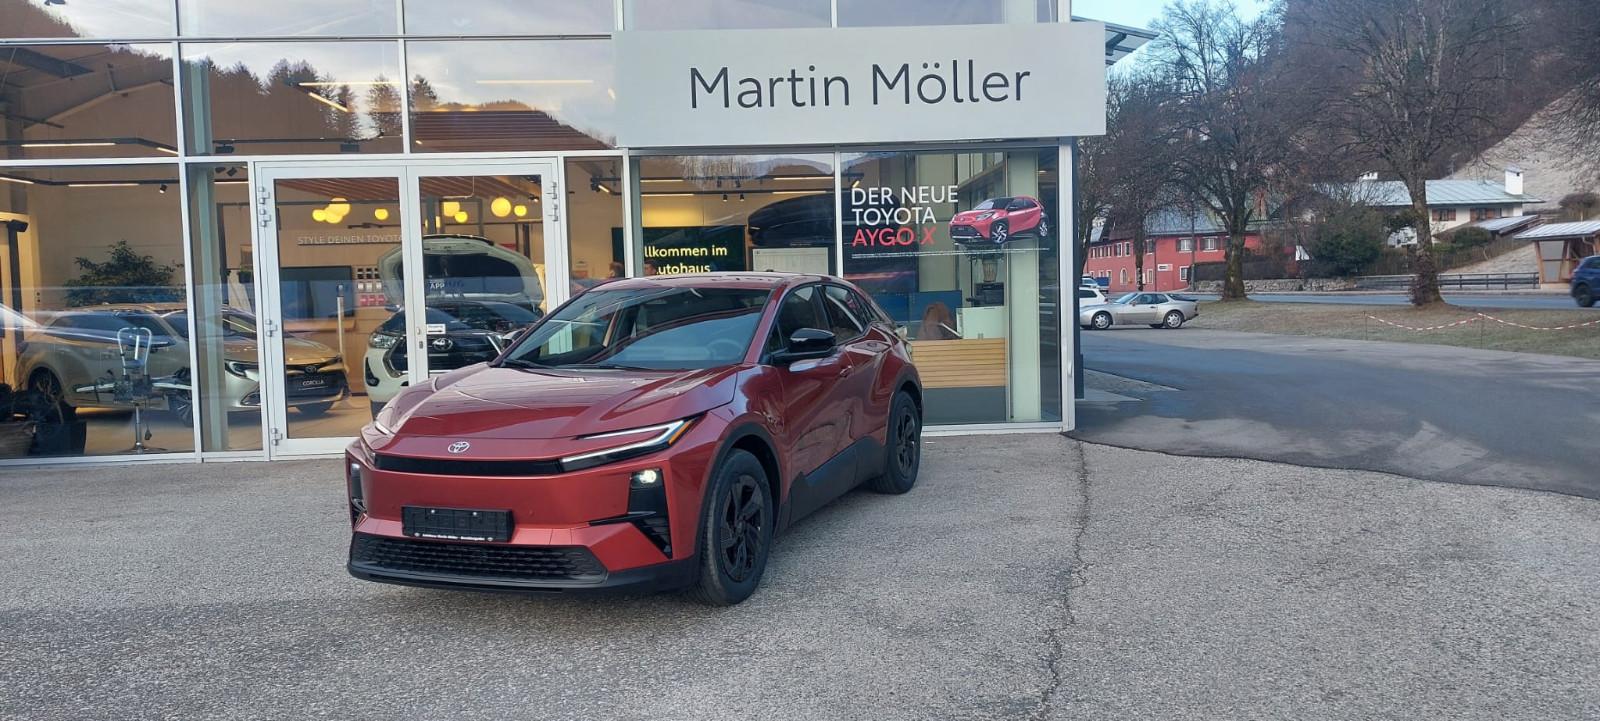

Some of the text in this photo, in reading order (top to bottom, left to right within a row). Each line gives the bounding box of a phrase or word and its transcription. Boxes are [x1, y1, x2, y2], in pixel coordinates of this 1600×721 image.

[690, 59, 1031, 109] Martin Möller
[852, 186, 959, 206] DER NEUE
[851, 207, 937, 226] TOYOTA
[298, 236, 325, 245] STYLE
[327, 235, 364, 244] DEINEN
[852, 227, 936, 247] AYGO X
[644, 244, 727, 257] llkommen im
[656, 262, 711, 275] utohaus
